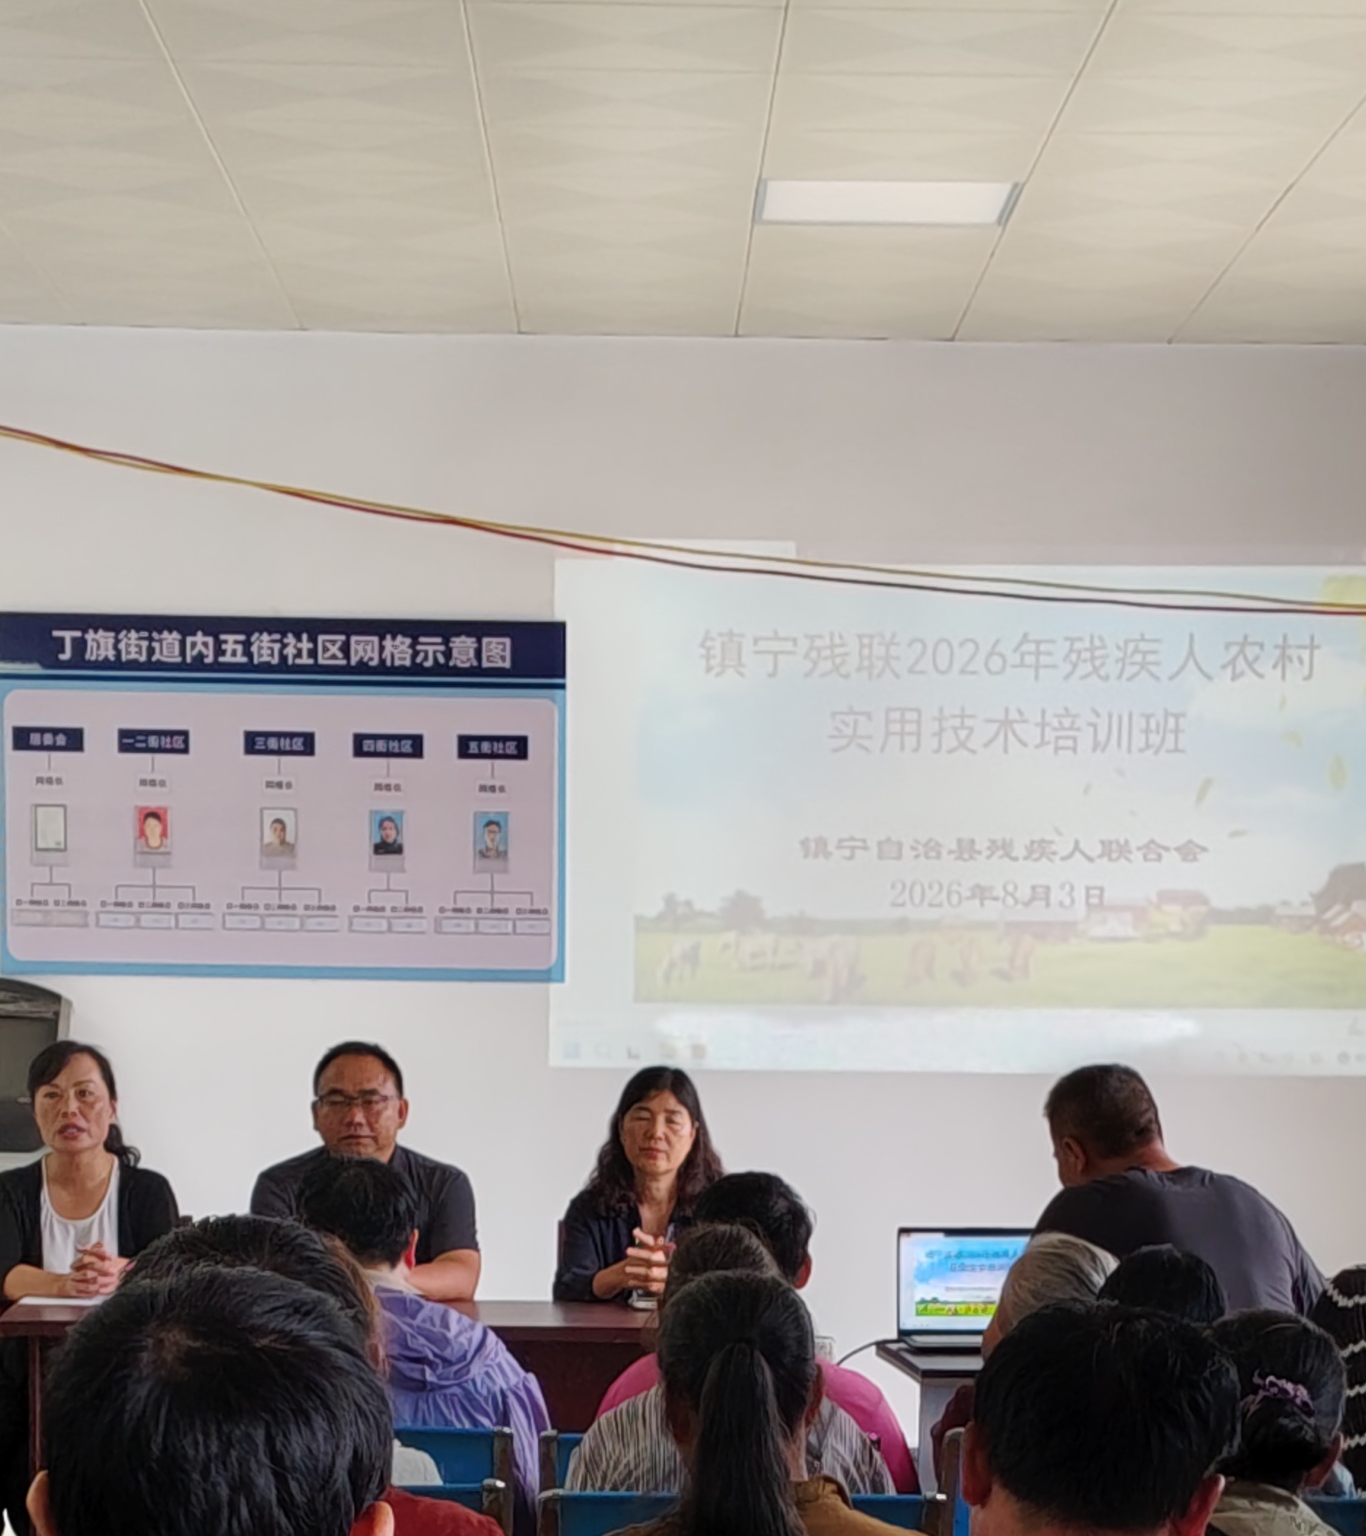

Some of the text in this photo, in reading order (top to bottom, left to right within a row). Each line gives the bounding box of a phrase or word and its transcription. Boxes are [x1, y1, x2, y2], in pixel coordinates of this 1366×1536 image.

[52, 629, 512, 671] 丁旗街道内五街社区网格示意图
[699, 627, 1321, 684] 镇宁残联2026年残疾人农村
[827, 704, 1188, 757] 实用技术培训班
[799, 835, 1209, 864] 镇宁自治县残疾人联合会
[889, 881, 1107, 911] 2026年8月3日
